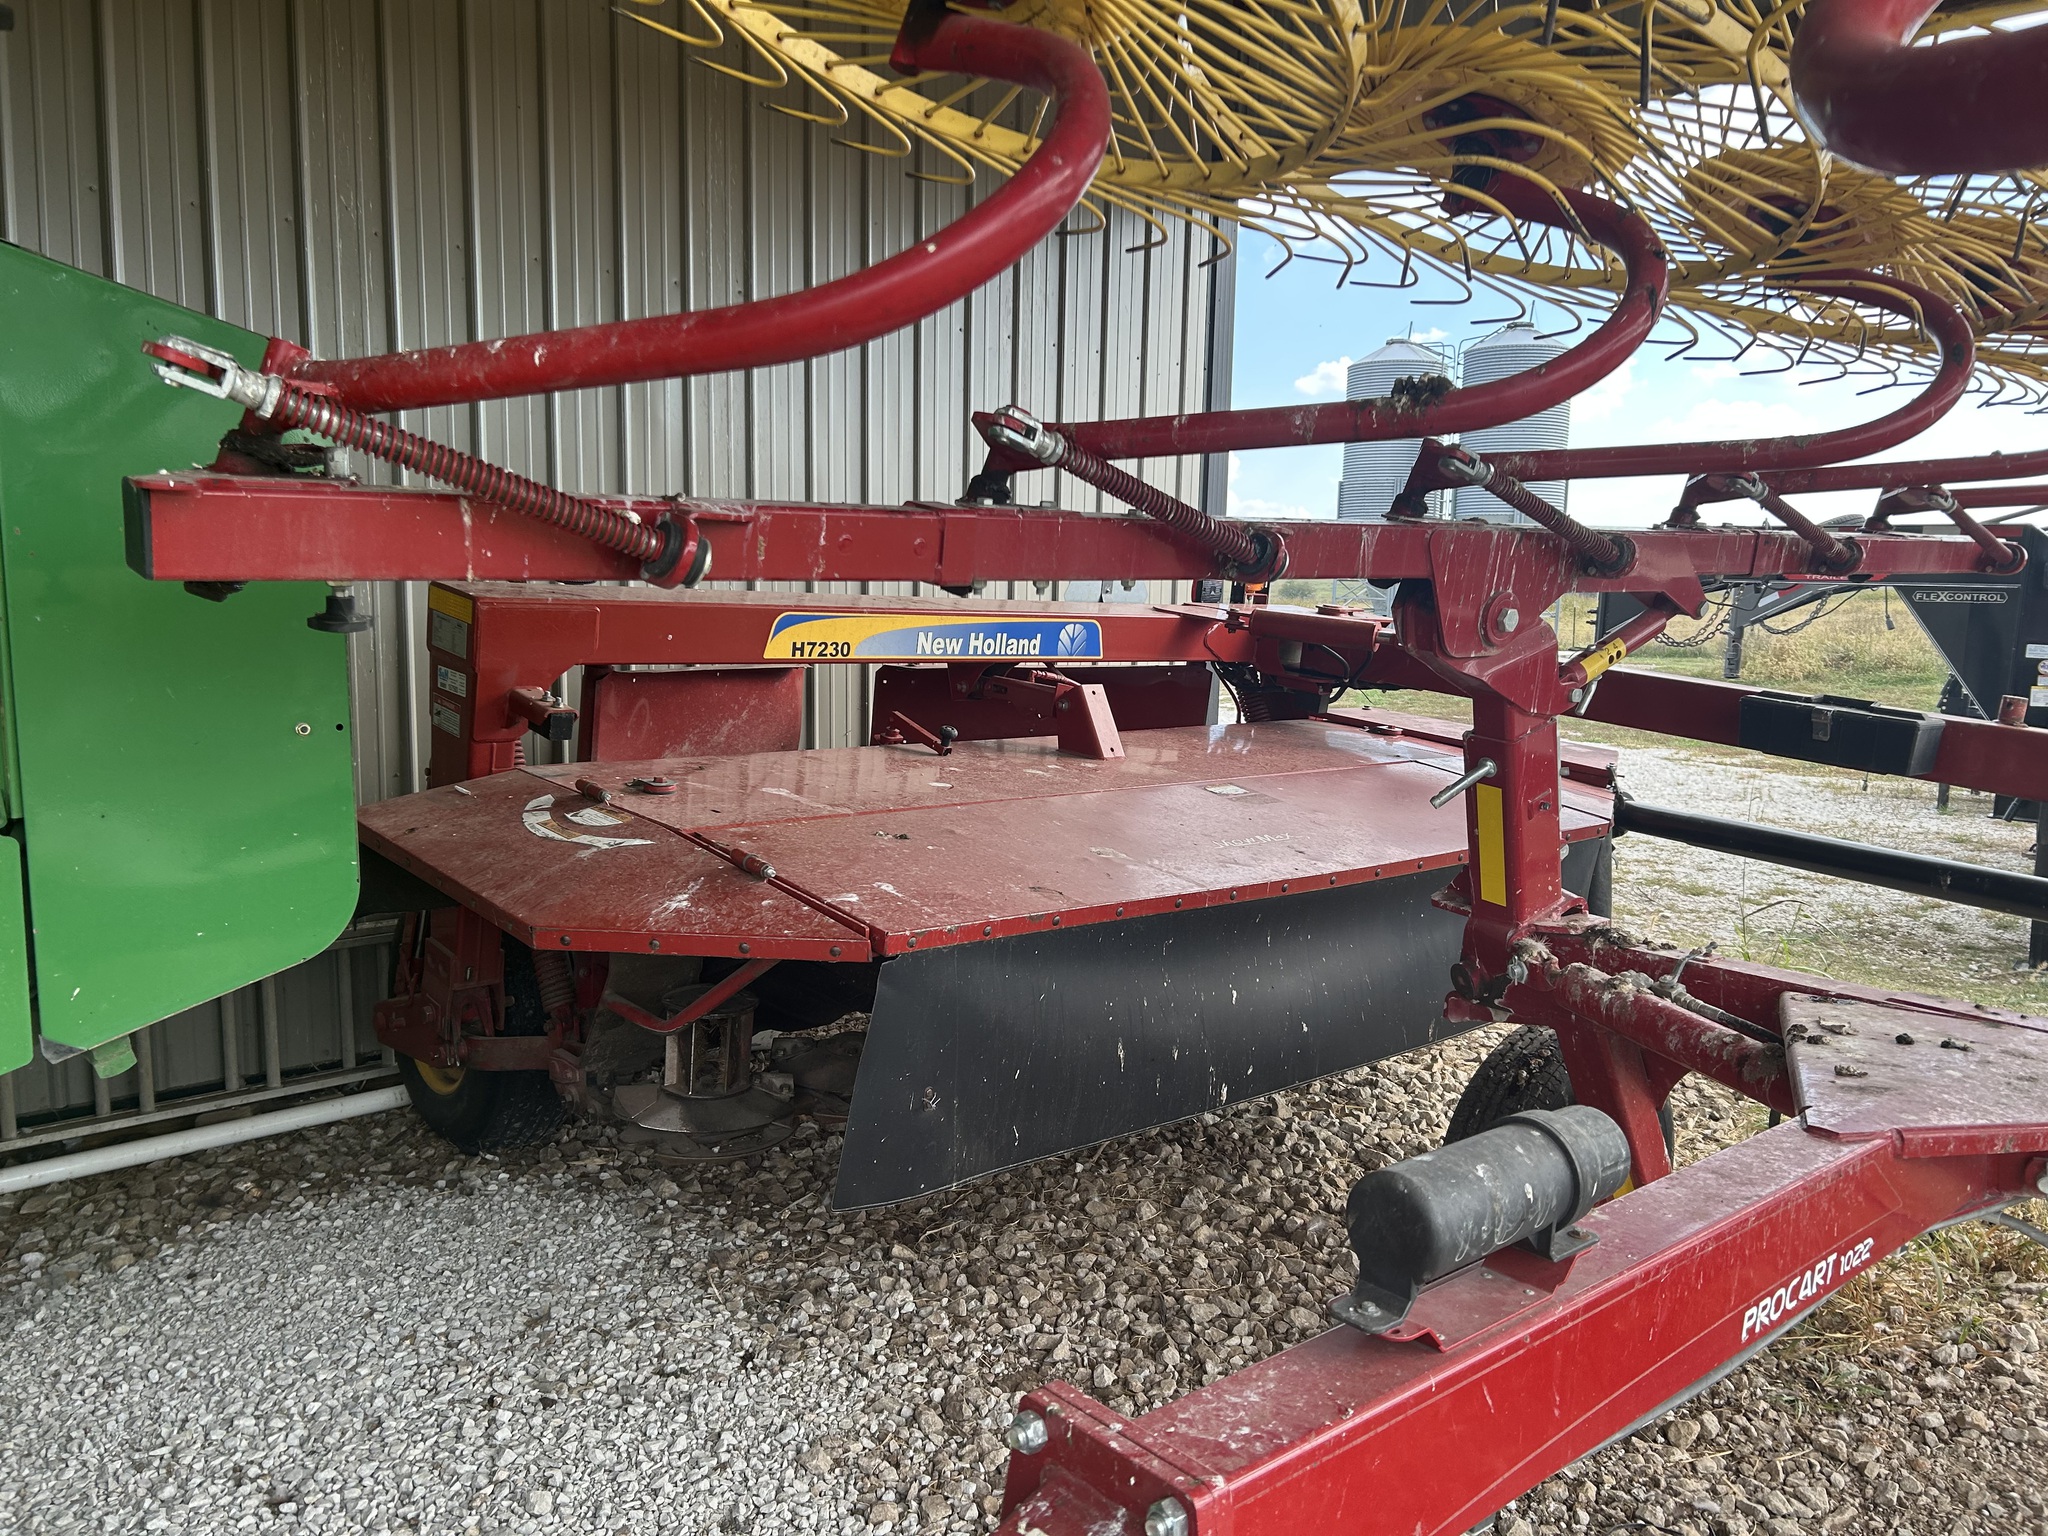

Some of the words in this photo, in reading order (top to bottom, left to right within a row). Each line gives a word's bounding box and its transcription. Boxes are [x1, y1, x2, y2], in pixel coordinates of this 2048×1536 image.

[1915, 591, 2004, 602] FLEXCONTROL
[791, 641, 851, 657] H7230
[916, 632, 964, 656] New
[968, 632, 1041, 656] Holland
[1741, 1252, 1837, 1343] PROCART
[1839, 1236, 1875, 1276] 1022
